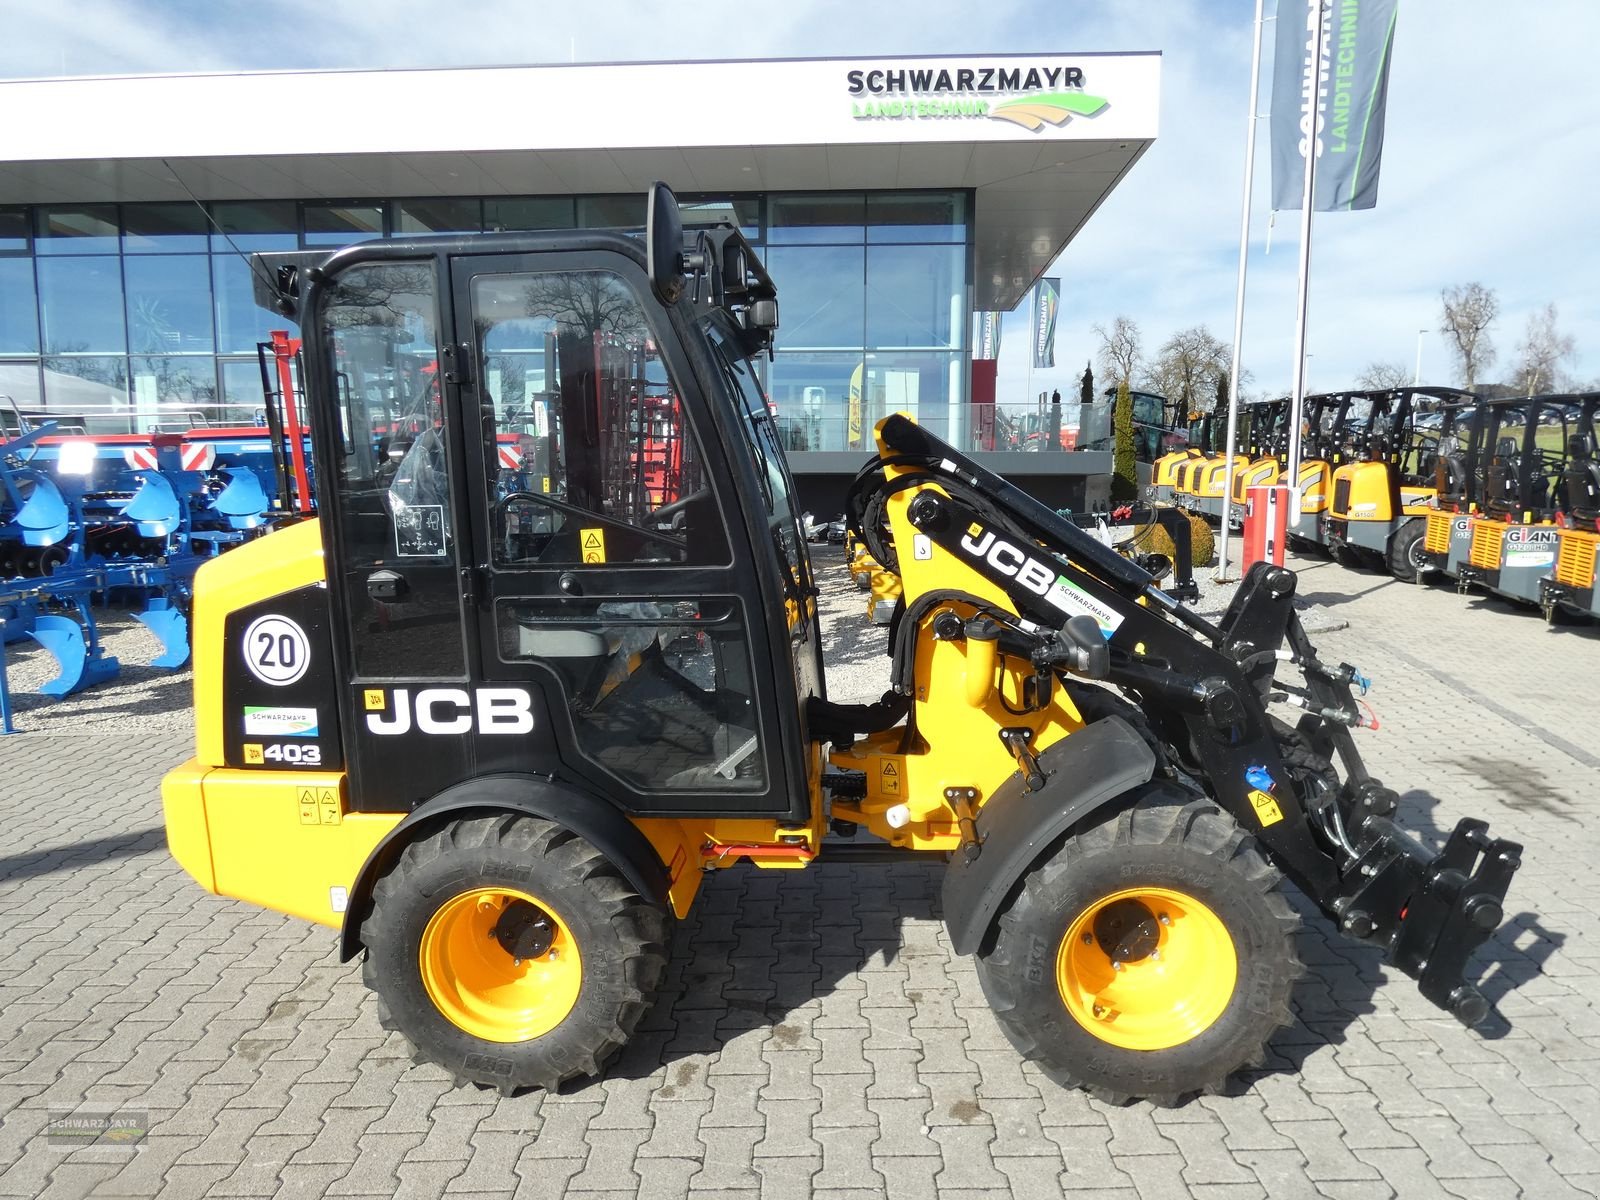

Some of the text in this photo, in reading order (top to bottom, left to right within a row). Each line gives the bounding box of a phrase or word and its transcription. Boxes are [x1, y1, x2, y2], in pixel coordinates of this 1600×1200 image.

[847, 67, 1083, 93] SCHWARZMAYR
[852, 99, 989, 117] LANDTECHNIK
[961, 531, 1055, 596] JCB
[1059, 585, 1111, 622] SCHWARZMAYR
[258, 632, 296, 668] 20
[252, 713, 307, 721] SCHWARZMAYR
[366, 688, 534, 735] JCB
[264, 743, 321, 762] 403
